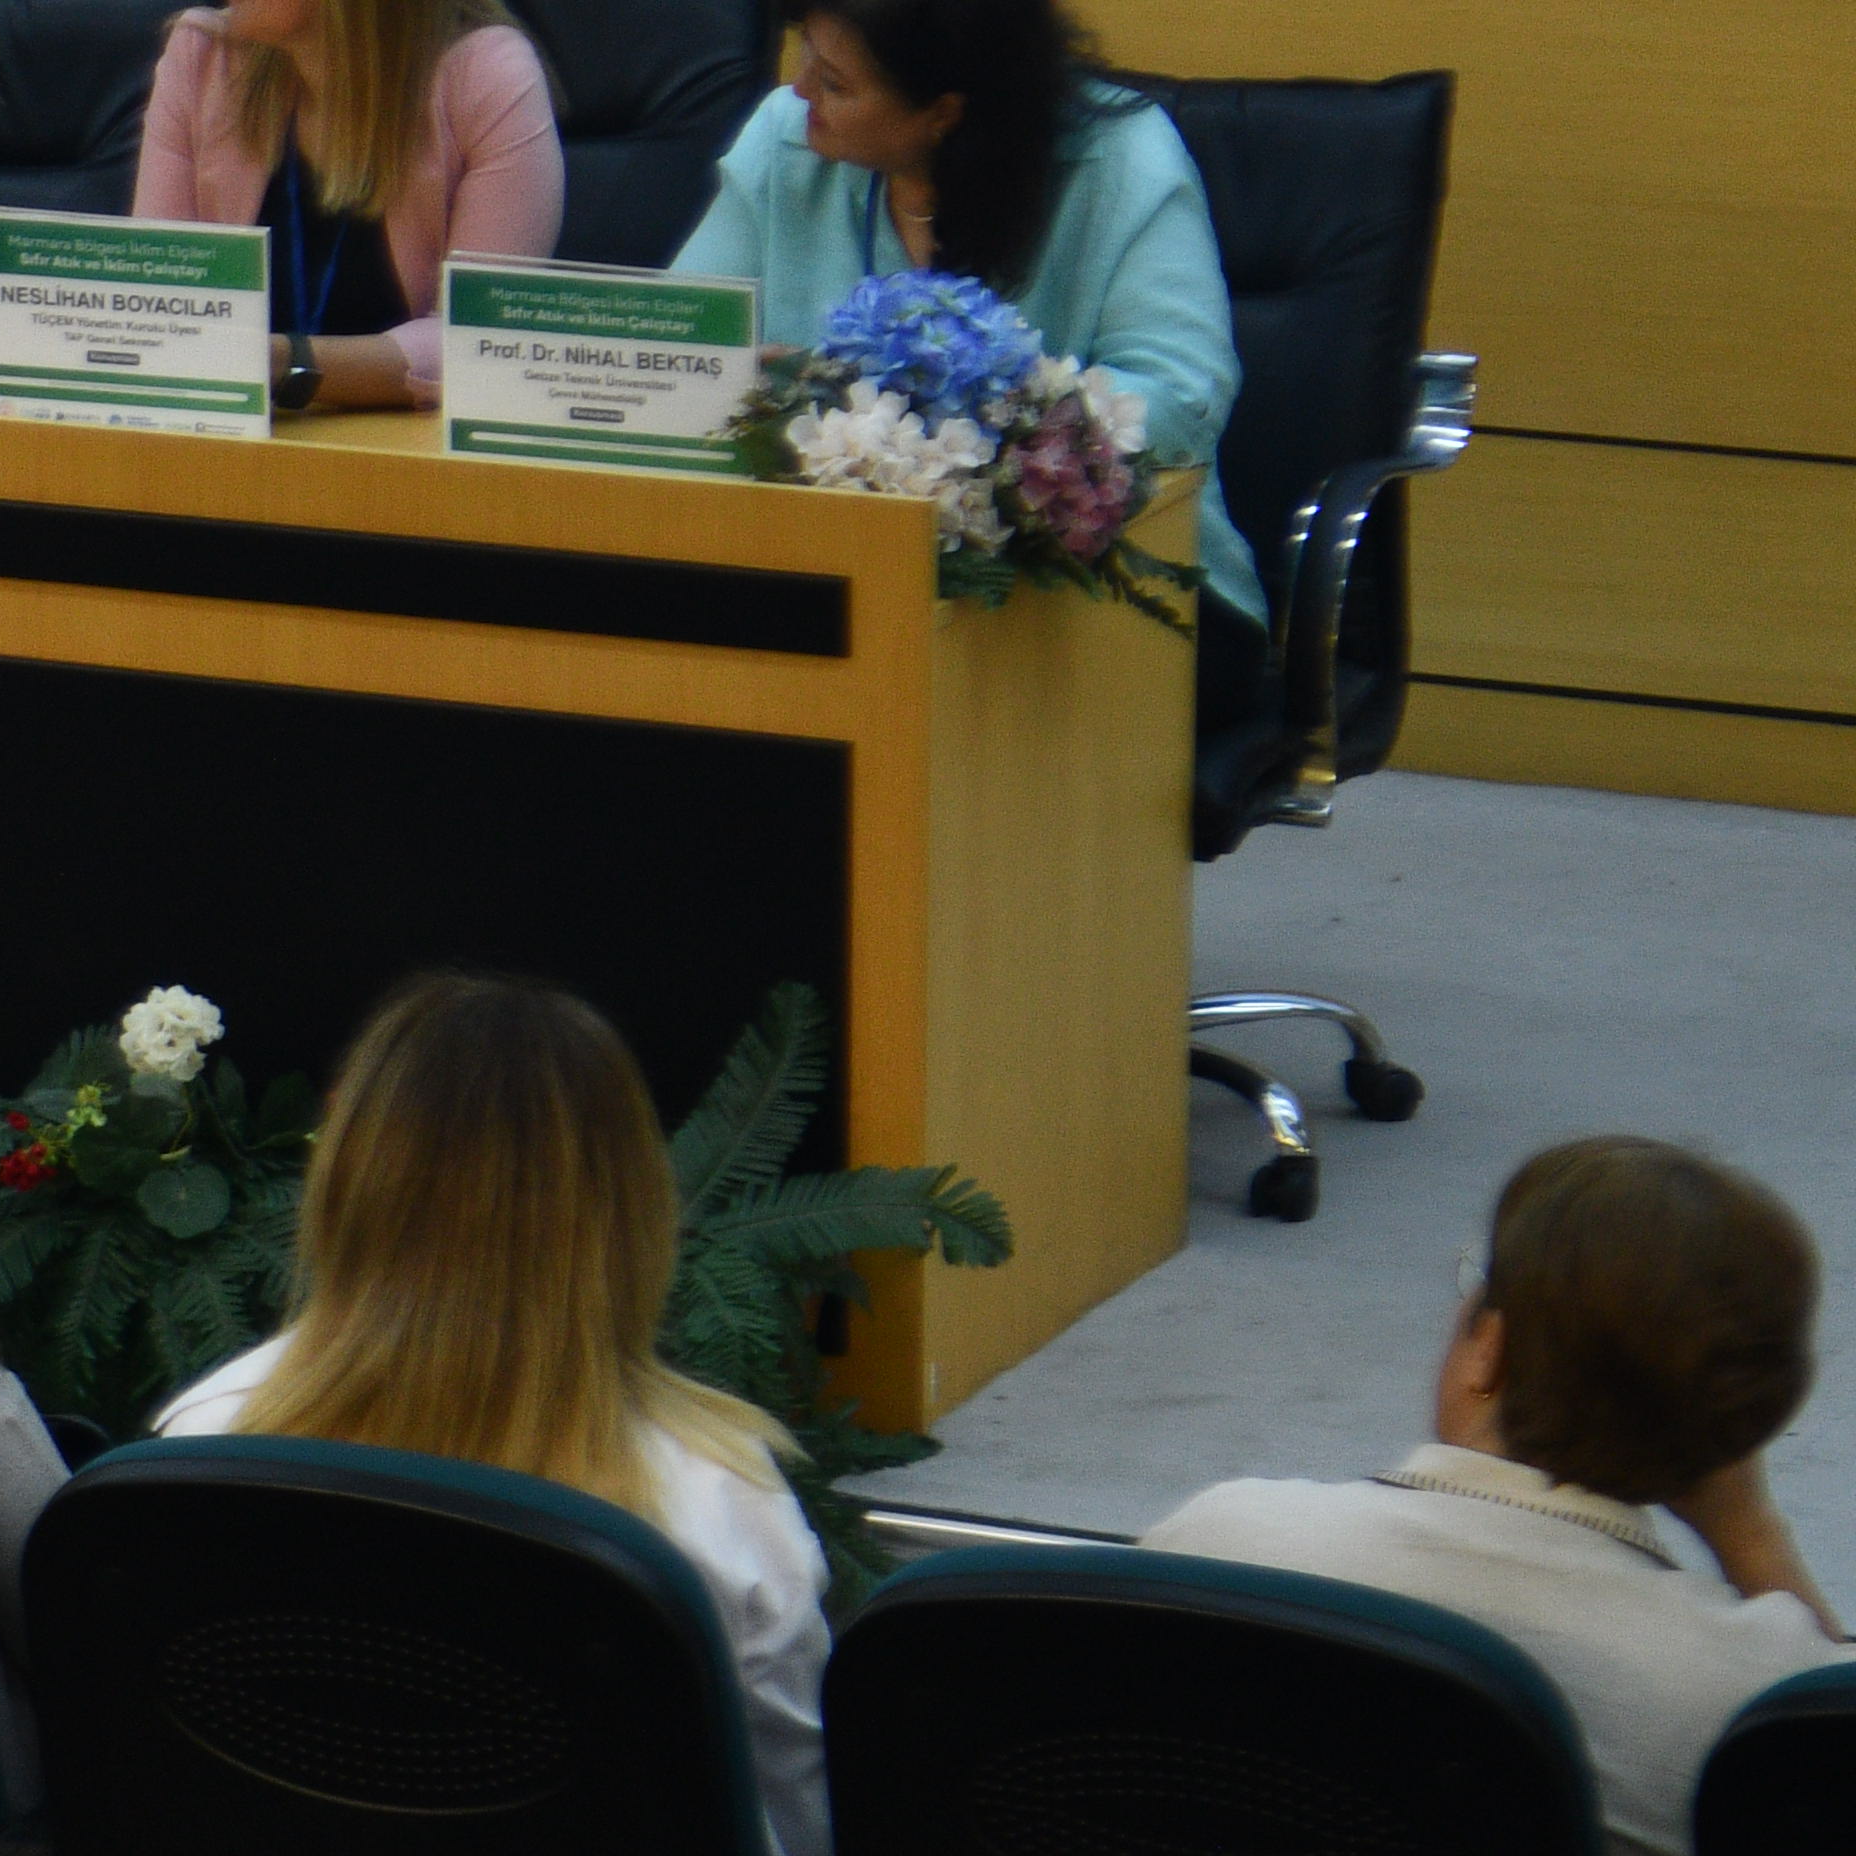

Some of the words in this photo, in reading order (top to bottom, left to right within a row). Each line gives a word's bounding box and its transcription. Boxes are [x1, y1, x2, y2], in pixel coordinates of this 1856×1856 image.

[0, 284, 105, 311] NESLİHAN
[112, 294, 233, 318] BOYACILAR
[479, 339, 526, 360] Prof.
[532, 343, 559, 363] Dr.
[564, 343, 630, 369] NİHAL
[636, 351, 723, 380] BEKTAŞ
